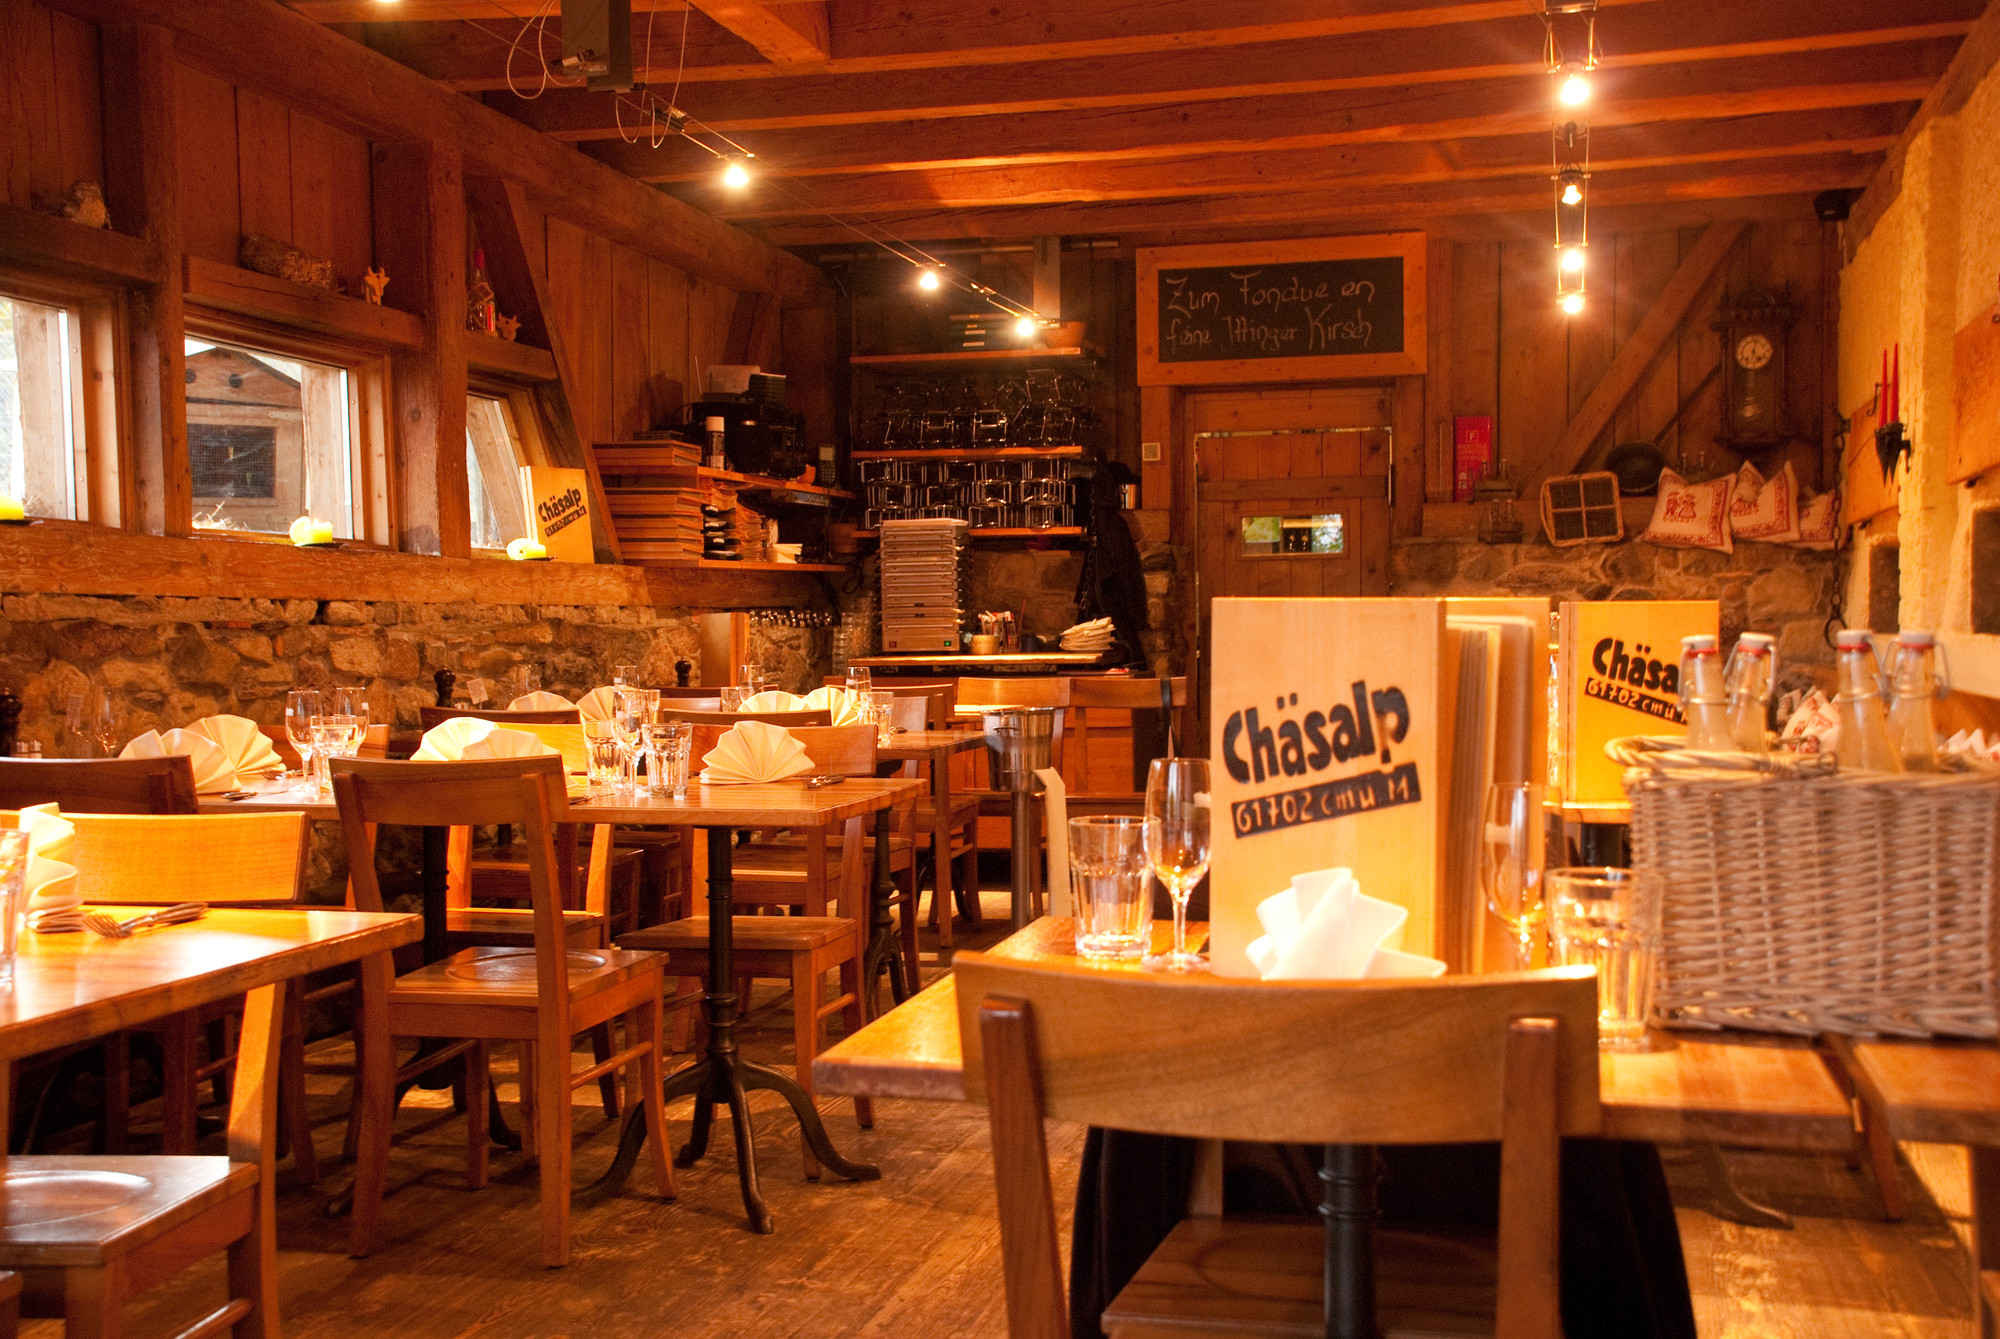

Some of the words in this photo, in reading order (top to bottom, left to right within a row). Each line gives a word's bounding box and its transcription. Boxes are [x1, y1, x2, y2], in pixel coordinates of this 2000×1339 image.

[1165, 276, 1220, 318] Zum
[1229, 270, 1329, 313] Fondue
[1341, 280, 1376, 303] en
[1165, 318, 1213, 355] feine
[1305, 303, 1372, 350] Kirsch
[538, 488, 582, 523] Chäsalp
[1592, 637, 1680, 695] Chäsa
[1587, 678, 1641, 709] 61702
[1222, 680, 1411, 784] Chäsalp
[1236, 791, 1314, 832] 61702
